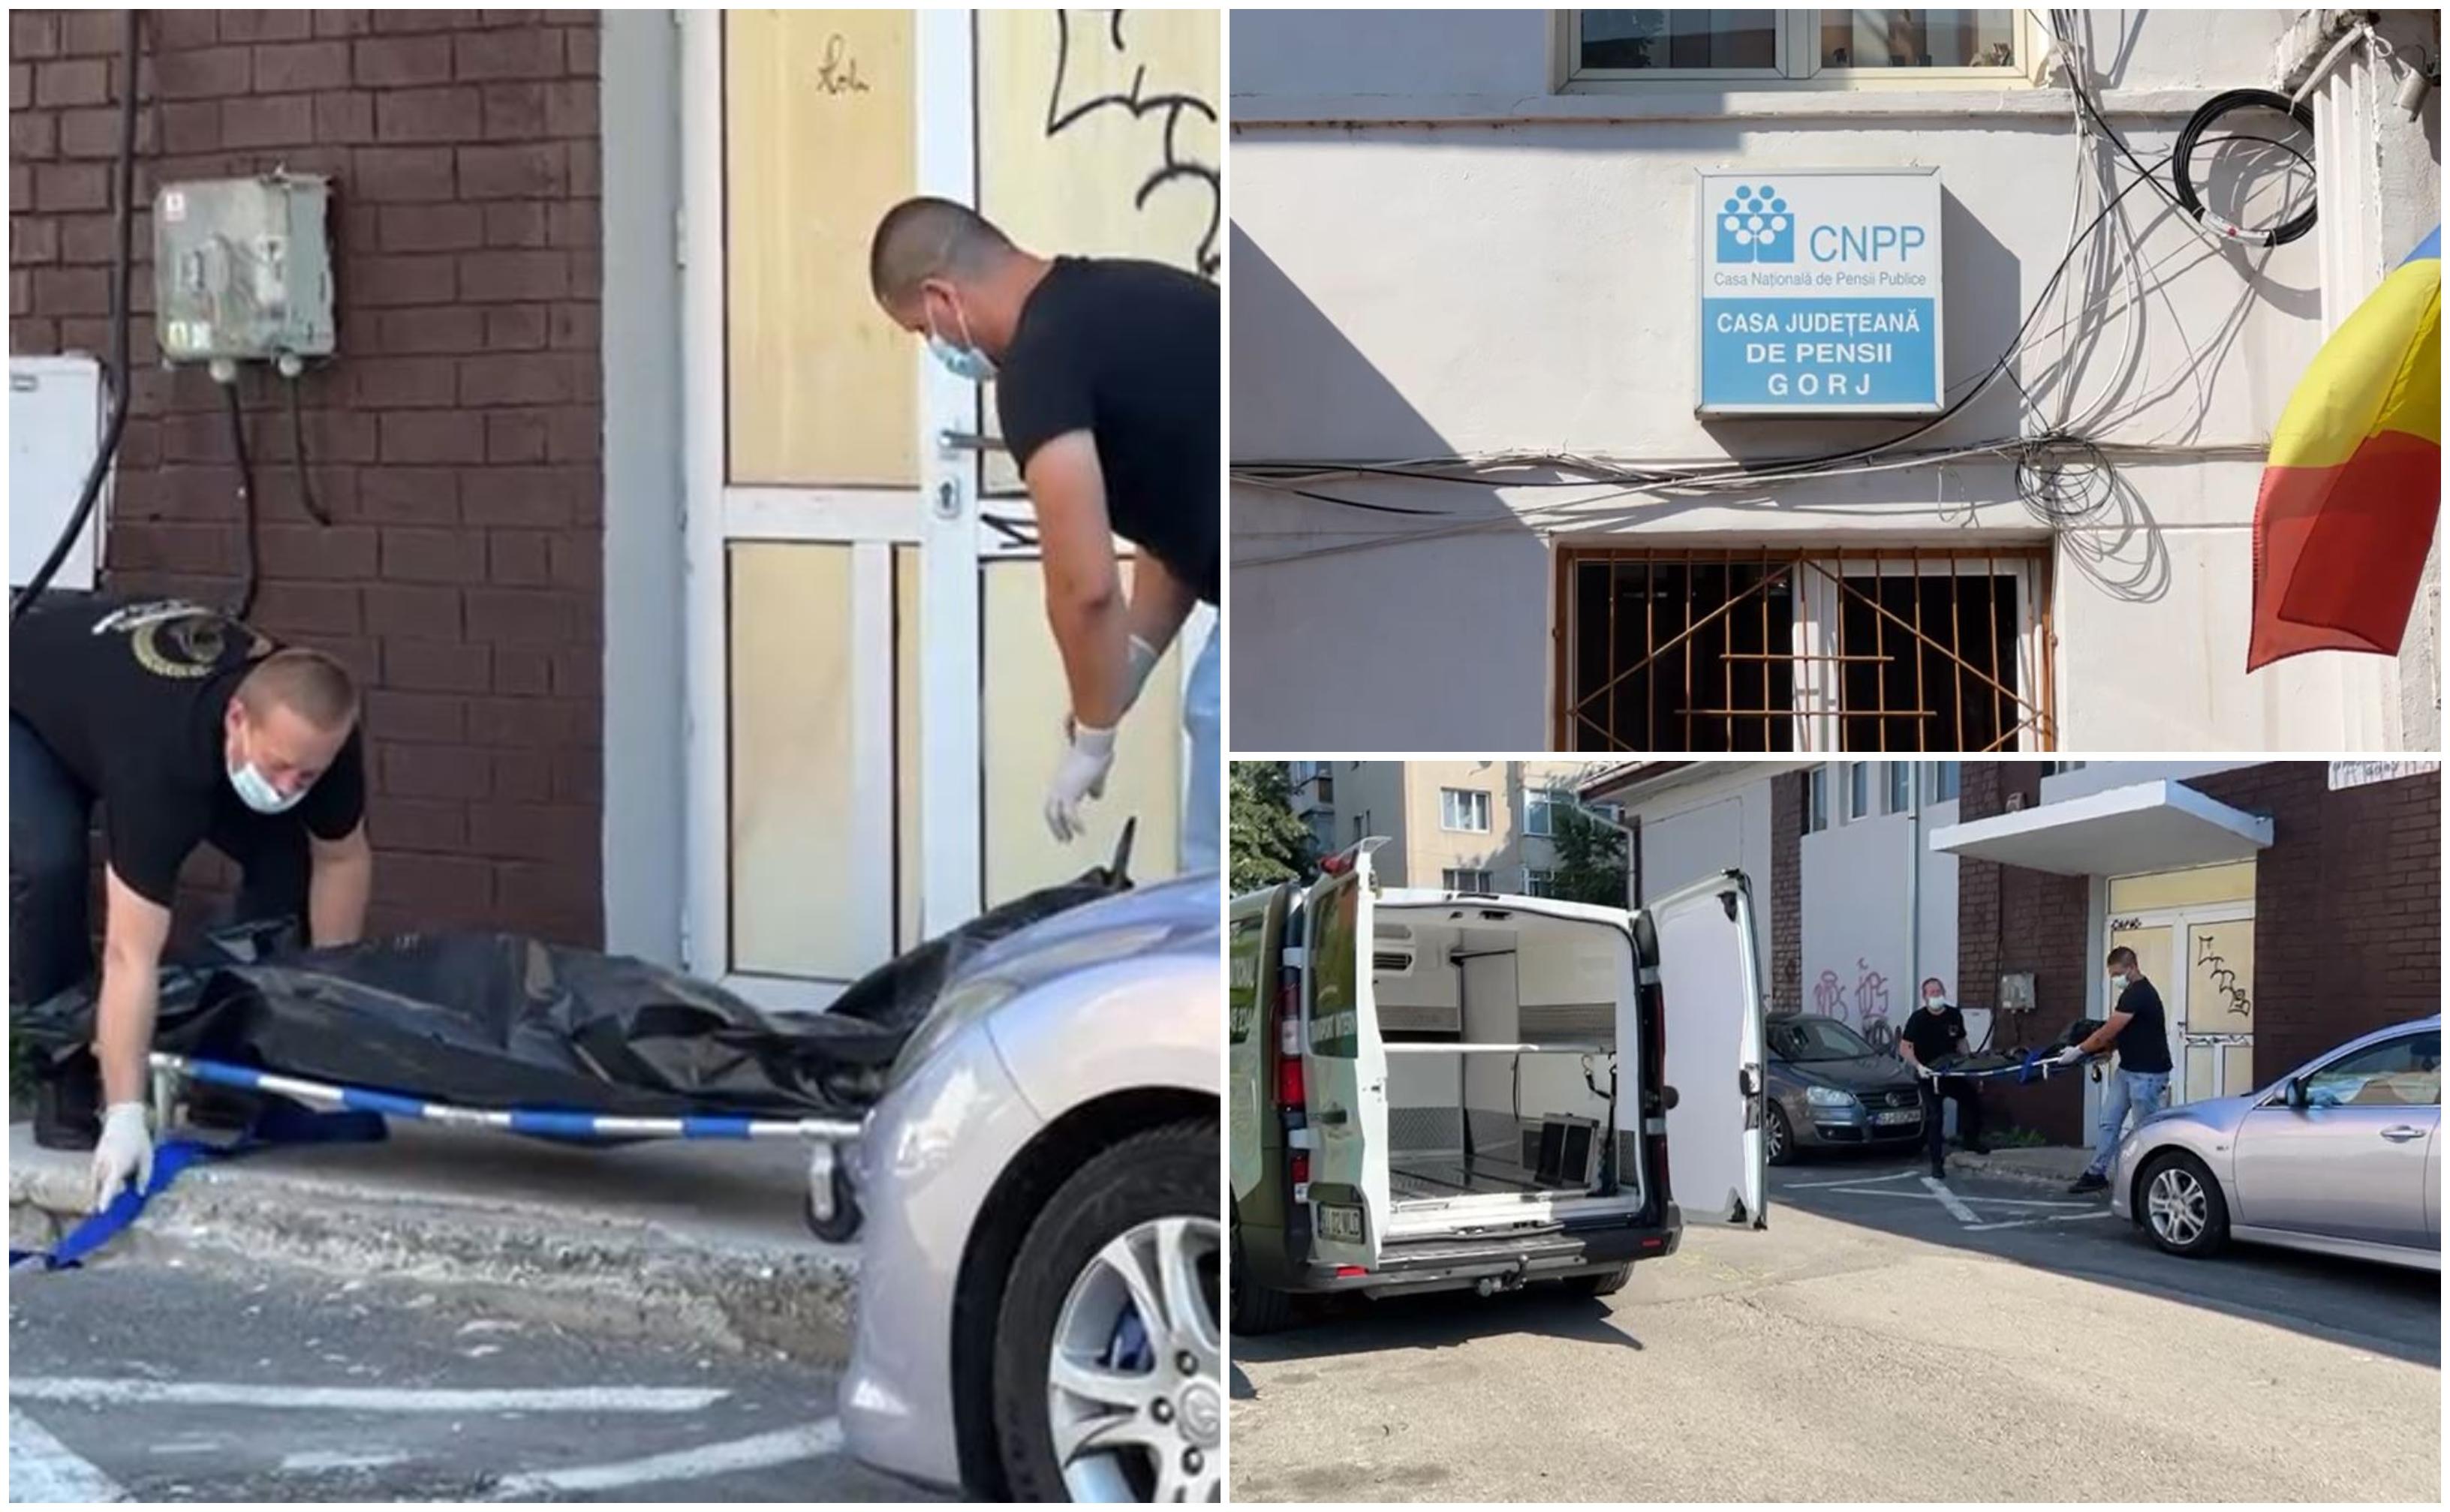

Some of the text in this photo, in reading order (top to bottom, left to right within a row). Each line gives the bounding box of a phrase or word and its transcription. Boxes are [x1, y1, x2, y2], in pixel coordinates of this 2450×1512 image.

[1809, 225, 1925, 263] CNPP
[1714, 272, 1747, 287] Casa
[1816, 272, 1832, 286] de
[1836, 272, 1875, 287] Pensii
[1880, 272, 1926, 286] Publice
[1717, 312, 1779, 333] CASA
[1746, 343, 1892, 364] DE PENSII
